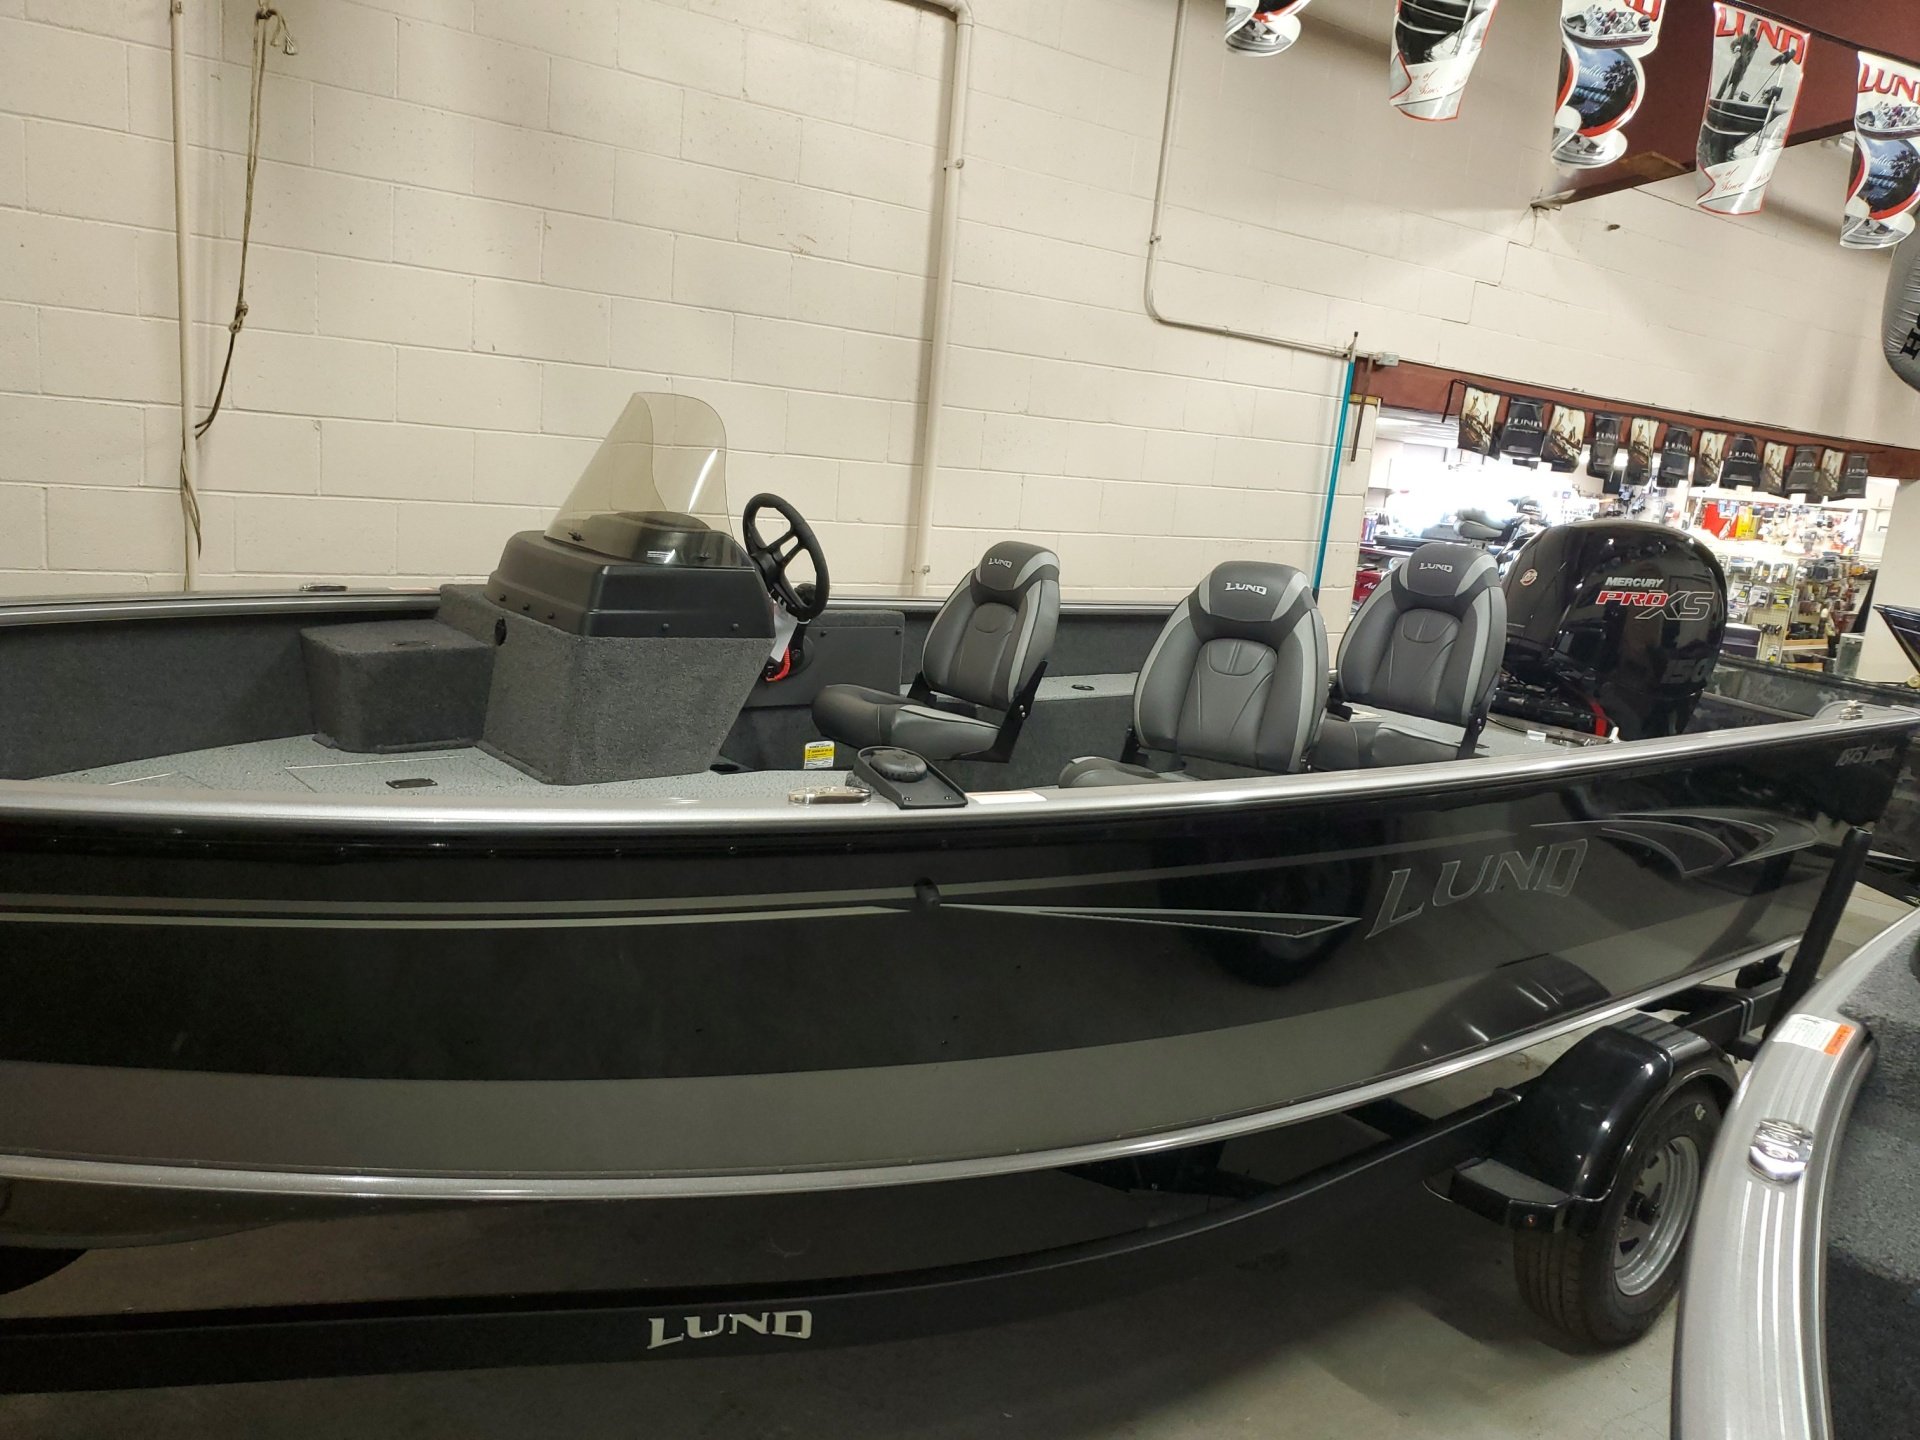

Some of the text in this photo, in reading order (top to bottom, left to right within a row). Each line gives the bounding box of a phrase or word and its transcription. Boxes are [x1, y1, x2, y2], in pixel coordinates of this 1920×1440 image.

[1715, 7, 1806, 65] LUND
[1857, 63, 1920, 106] LUN
[988, 557, 1013, 569] LUND
[1419, 562, 1453, 573] LUND
[1224, 582, 1267, 595] LUND
[1604, 576, 1664, 588] MERCURY
[1595, 590, 1715, 620] PRO XS
[1364, 838, 1588, 940] LUND
[647, 1309, 812, 1350] LUND
